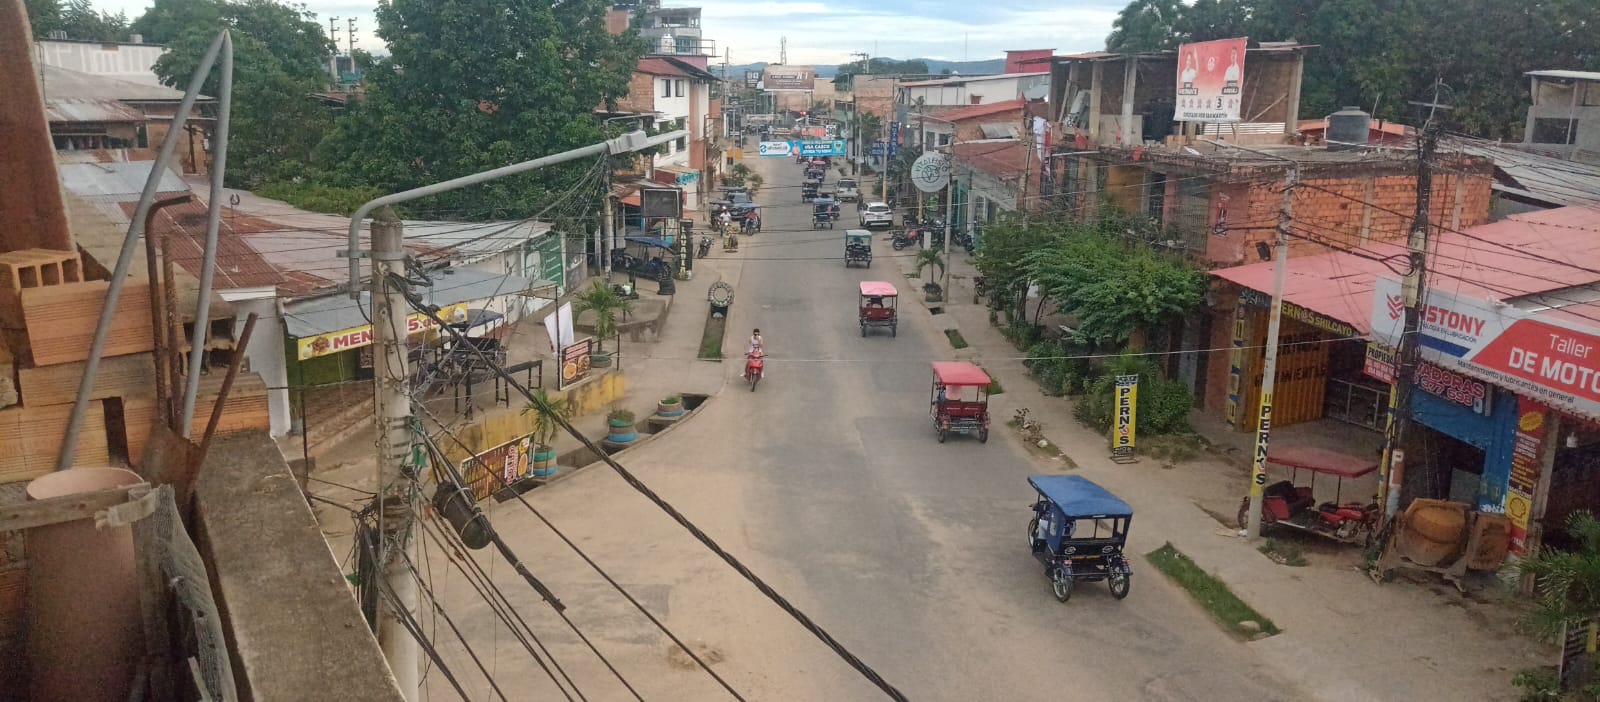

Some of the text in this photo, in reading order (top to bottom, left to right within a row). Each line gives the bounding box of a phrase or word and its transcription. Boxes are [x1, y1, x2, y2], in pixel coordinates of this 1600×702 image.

[1216, 97, 1222, 108] 3
[1281, 302, 1353, 337] ERNOS SHILCAYO
[333, 330, 374, 349] MEN
[1548, 333, 1593, 359] Taller
[1508, 347, 1538, 373] DE
[1457, 360, 1499, 379] Mantenimiento
[1539, 388, 1548, 396] en
[1548, 389, 1575, 404] general
